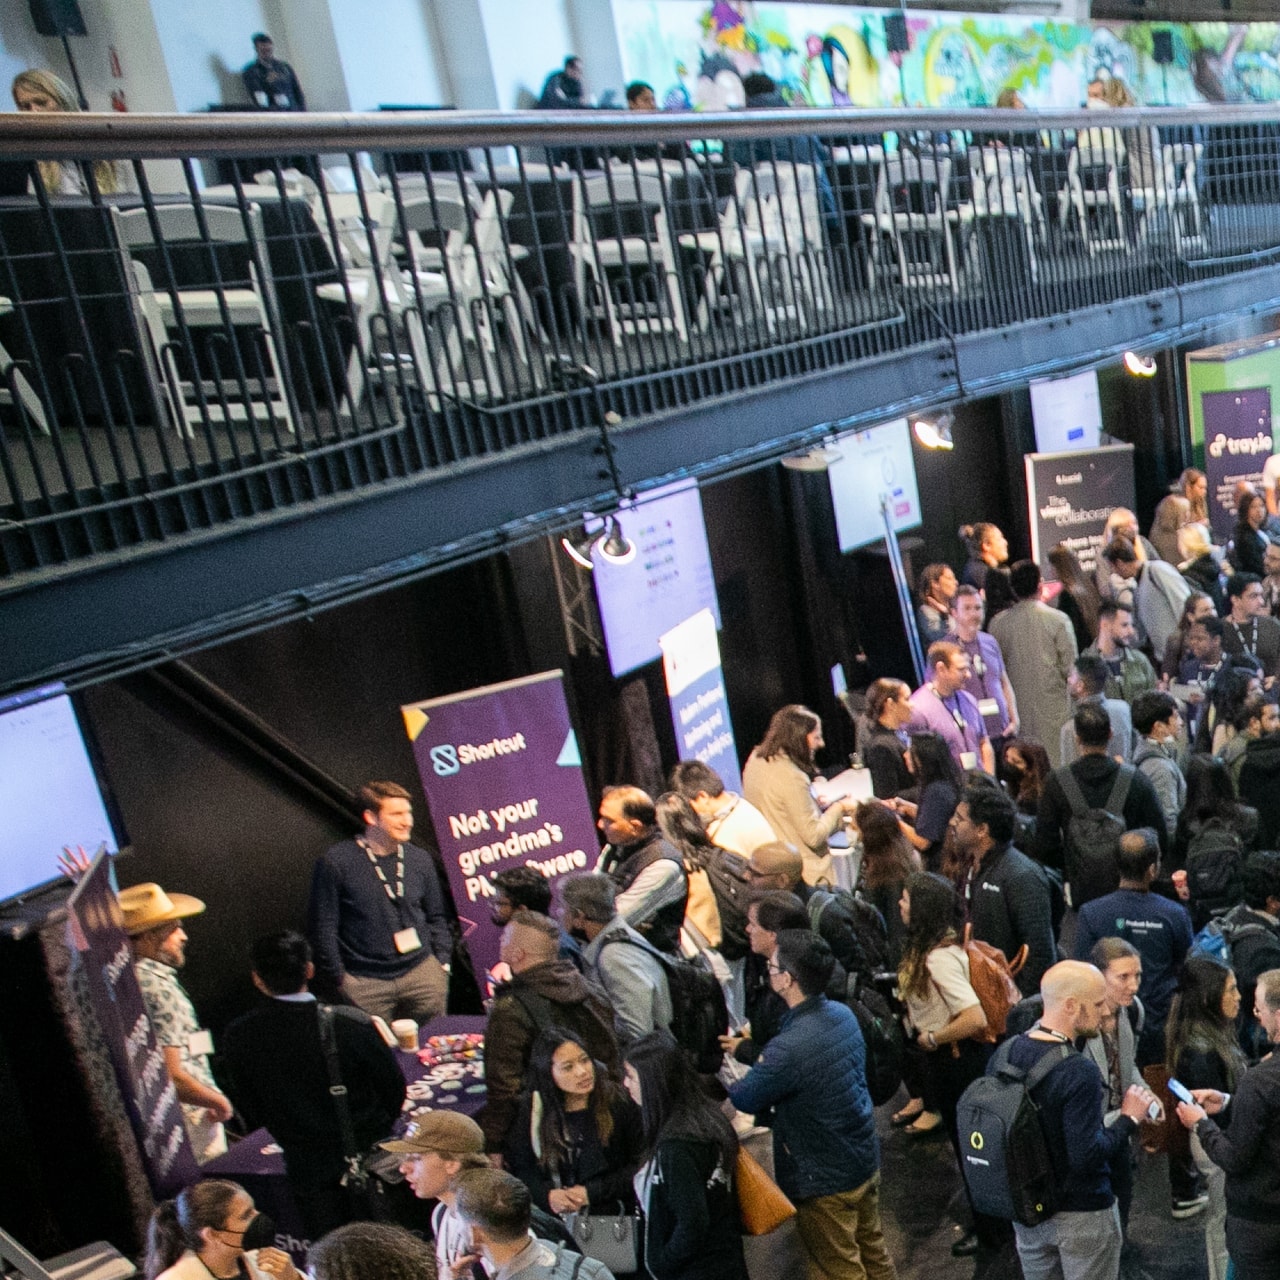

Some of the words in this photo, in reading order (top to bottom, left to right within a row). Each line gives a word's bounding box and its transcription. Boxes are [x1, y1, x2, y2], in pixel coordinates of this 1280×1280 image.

[458, 732, 527, 765] Shortcut
[449, 809, 491, 840] Not
[490, 798, 538, 832] your
[458, 822, 563, 876] grandma's
